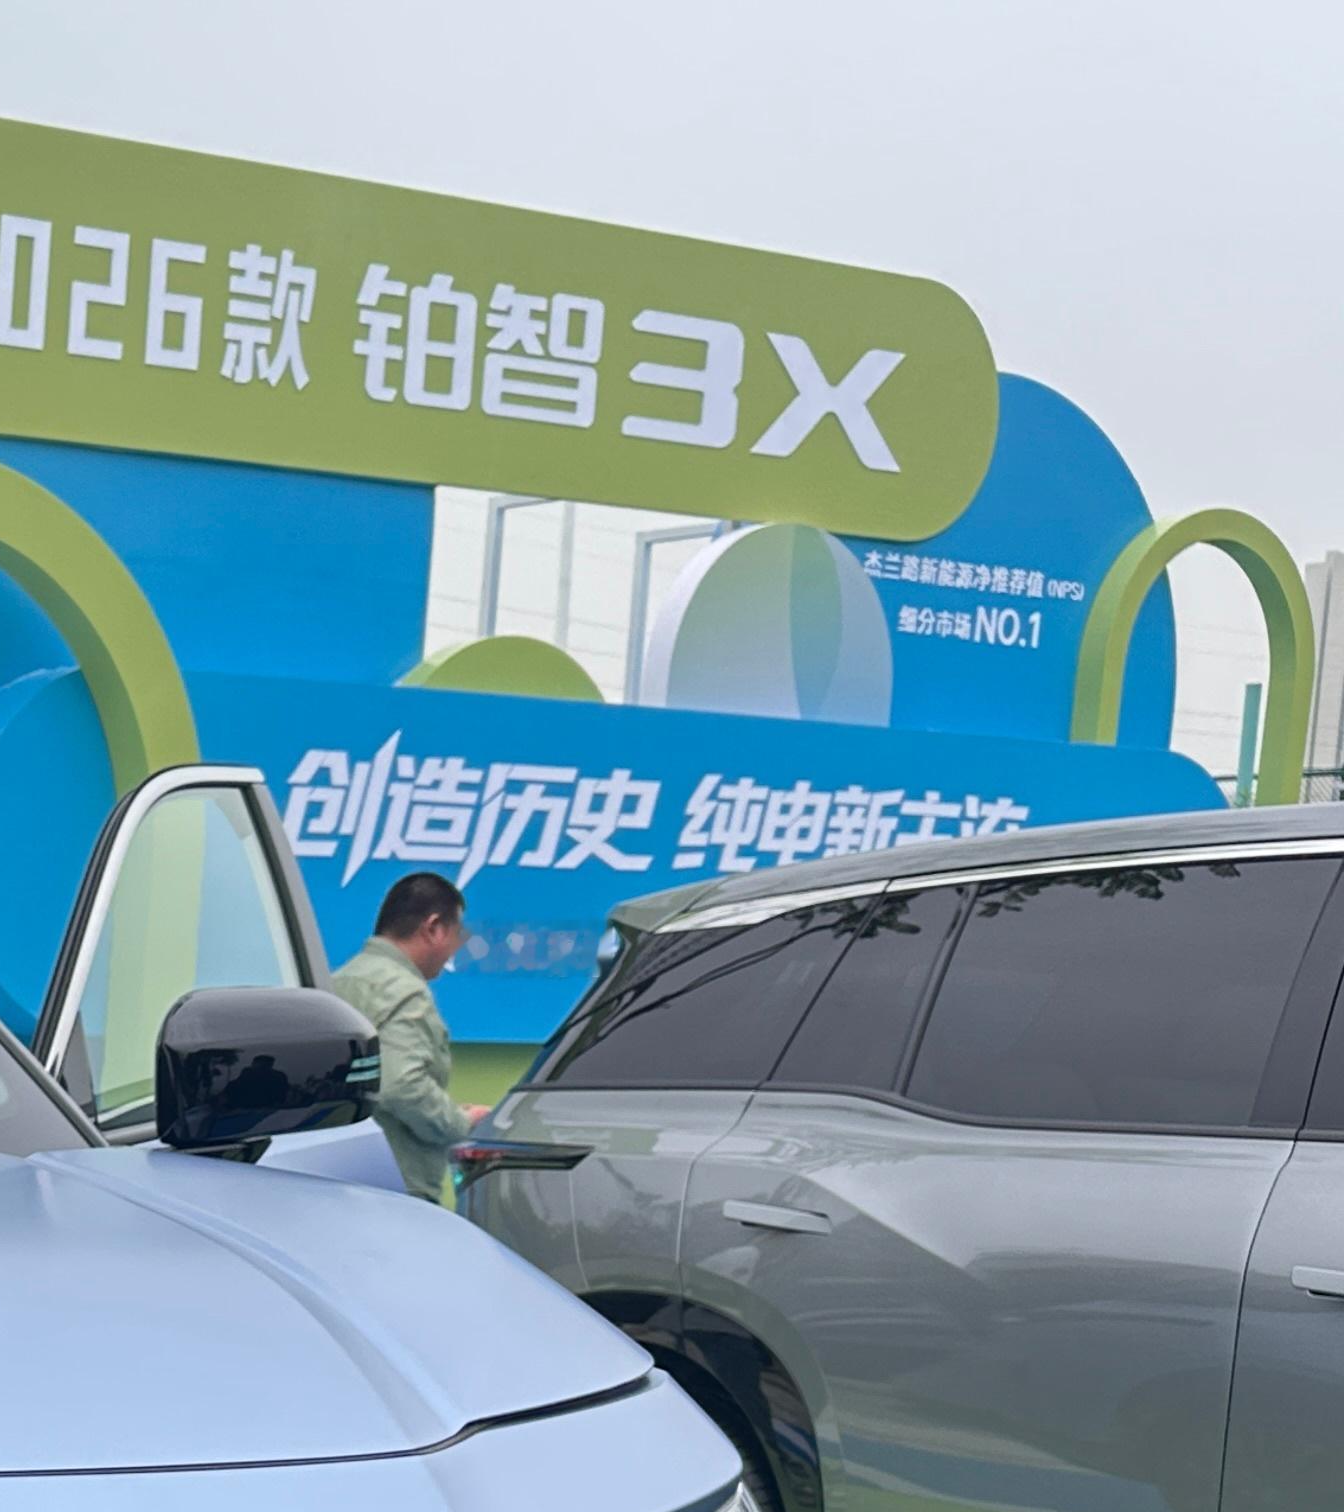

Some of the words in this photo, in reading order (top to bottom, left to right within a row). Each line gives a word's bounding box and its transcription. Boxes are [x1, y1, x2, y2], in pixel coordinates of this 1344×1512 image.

[353, 263, 906, 472] 铂智3X
[973, 606, 1042, 649] NO.1
[284, 729, 661, 890] 创造历史
